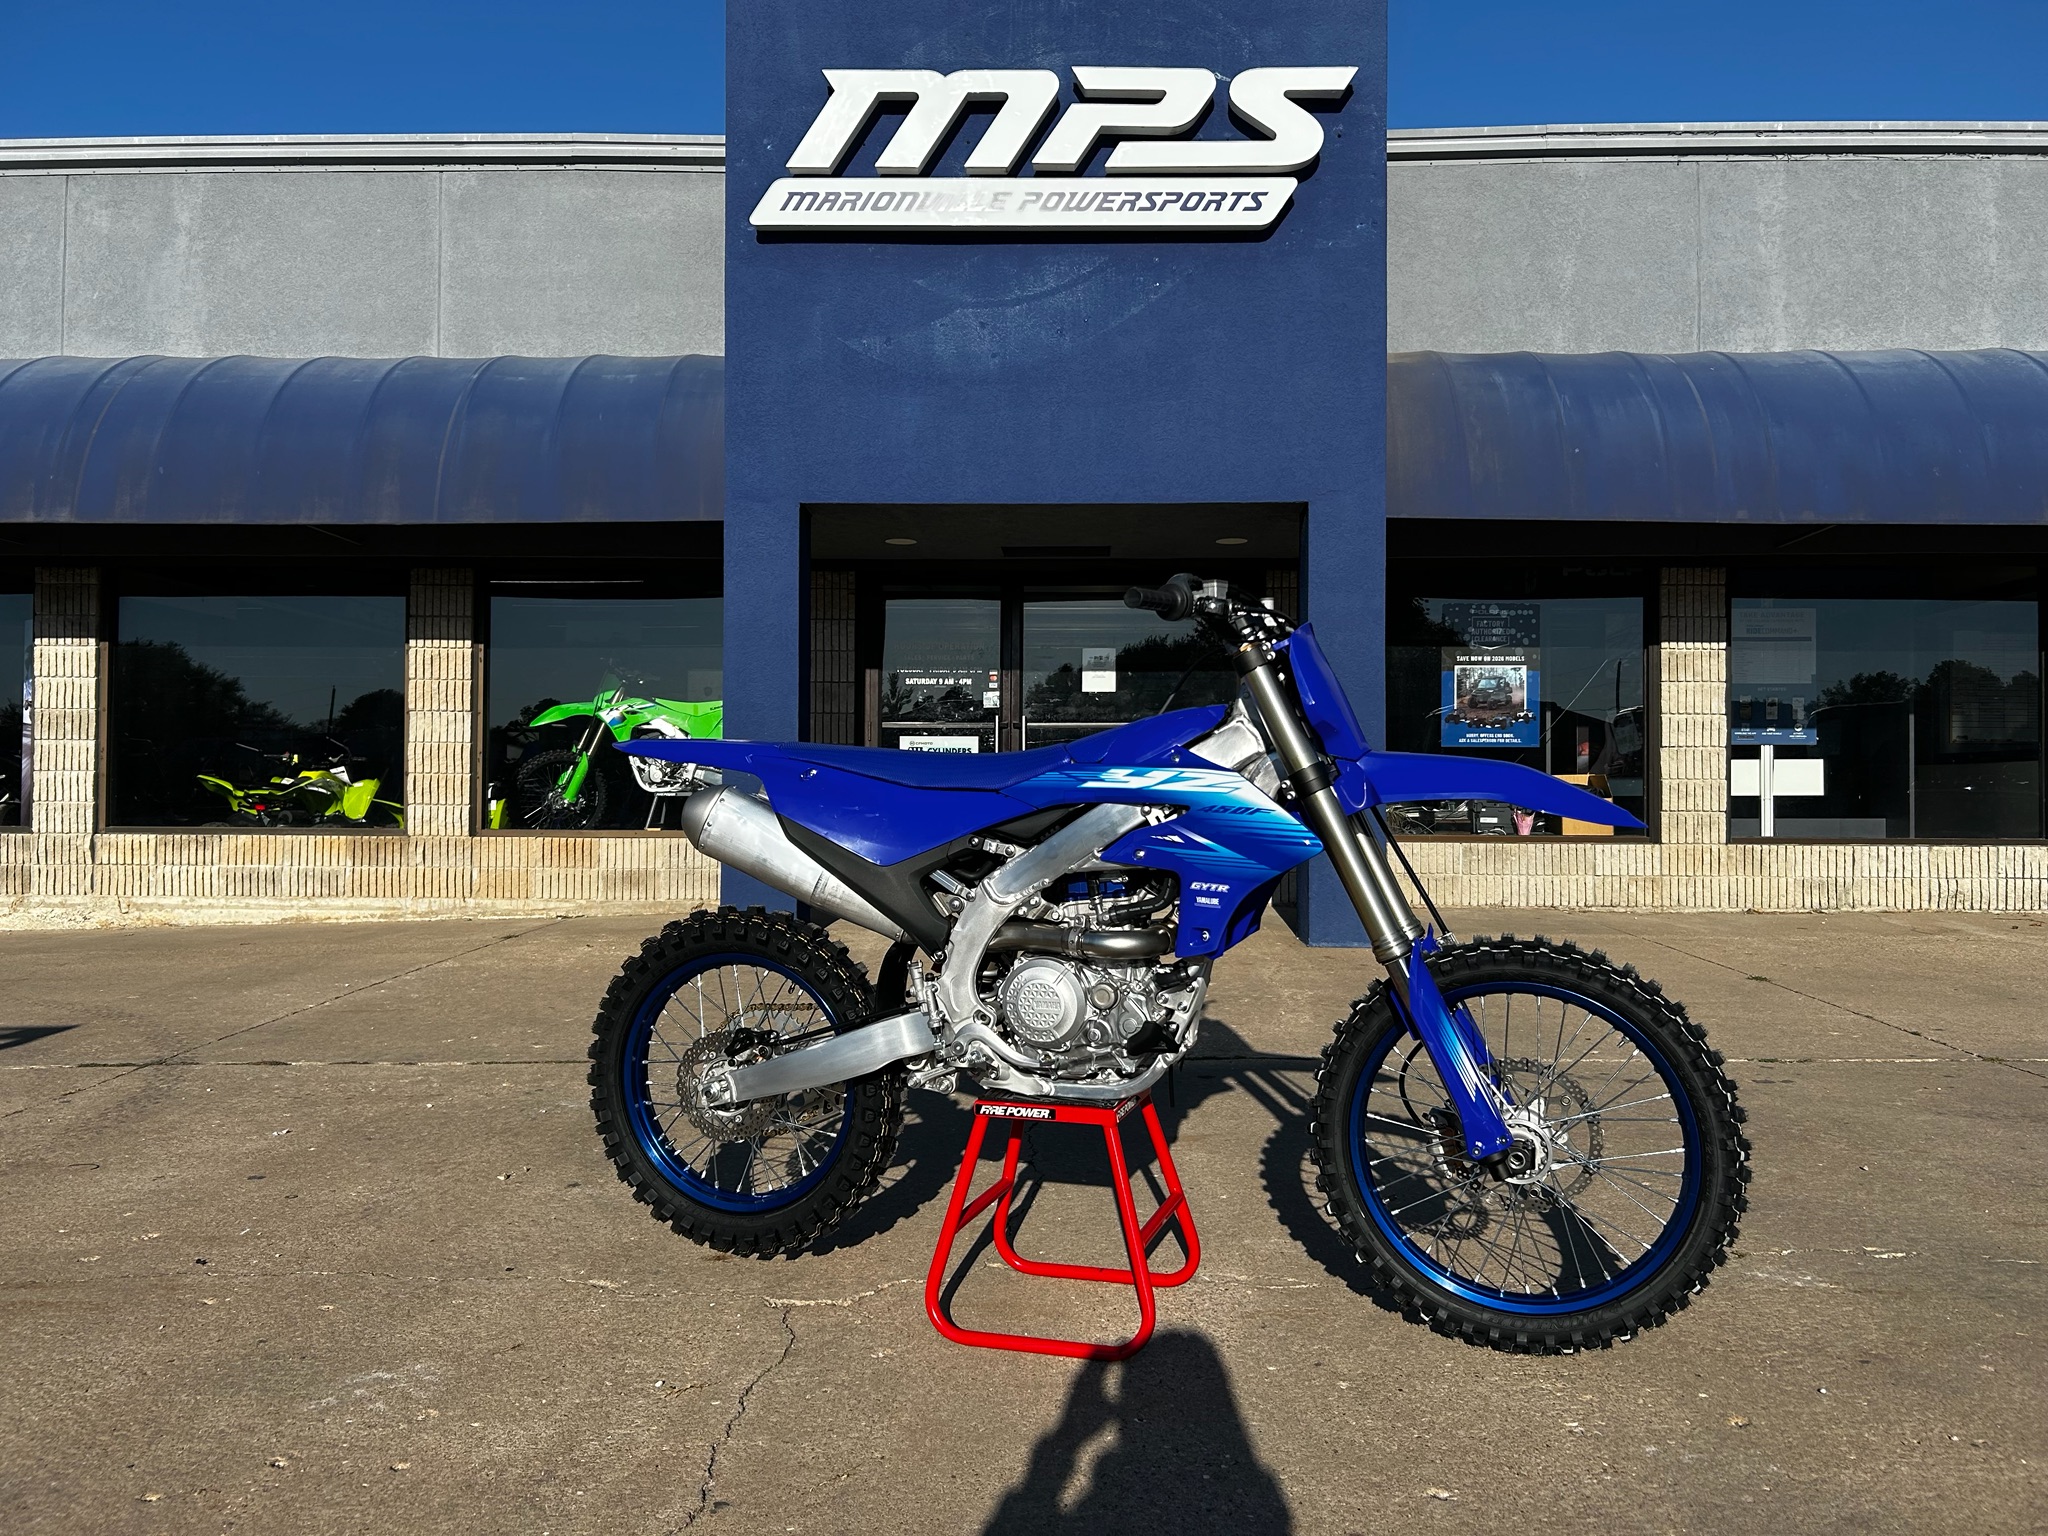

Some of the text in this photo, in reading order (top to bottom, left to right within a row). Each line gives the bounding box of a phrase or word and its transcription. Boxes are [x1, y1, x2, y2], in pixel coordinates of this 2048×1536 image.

[785, 66, 1359, 174] MPS
[1017, 191, 1270, 212] POWERSPORTS
[1196, 804, 1276, 816] 450F
[1189, 881, 1231, 893] GYTR
